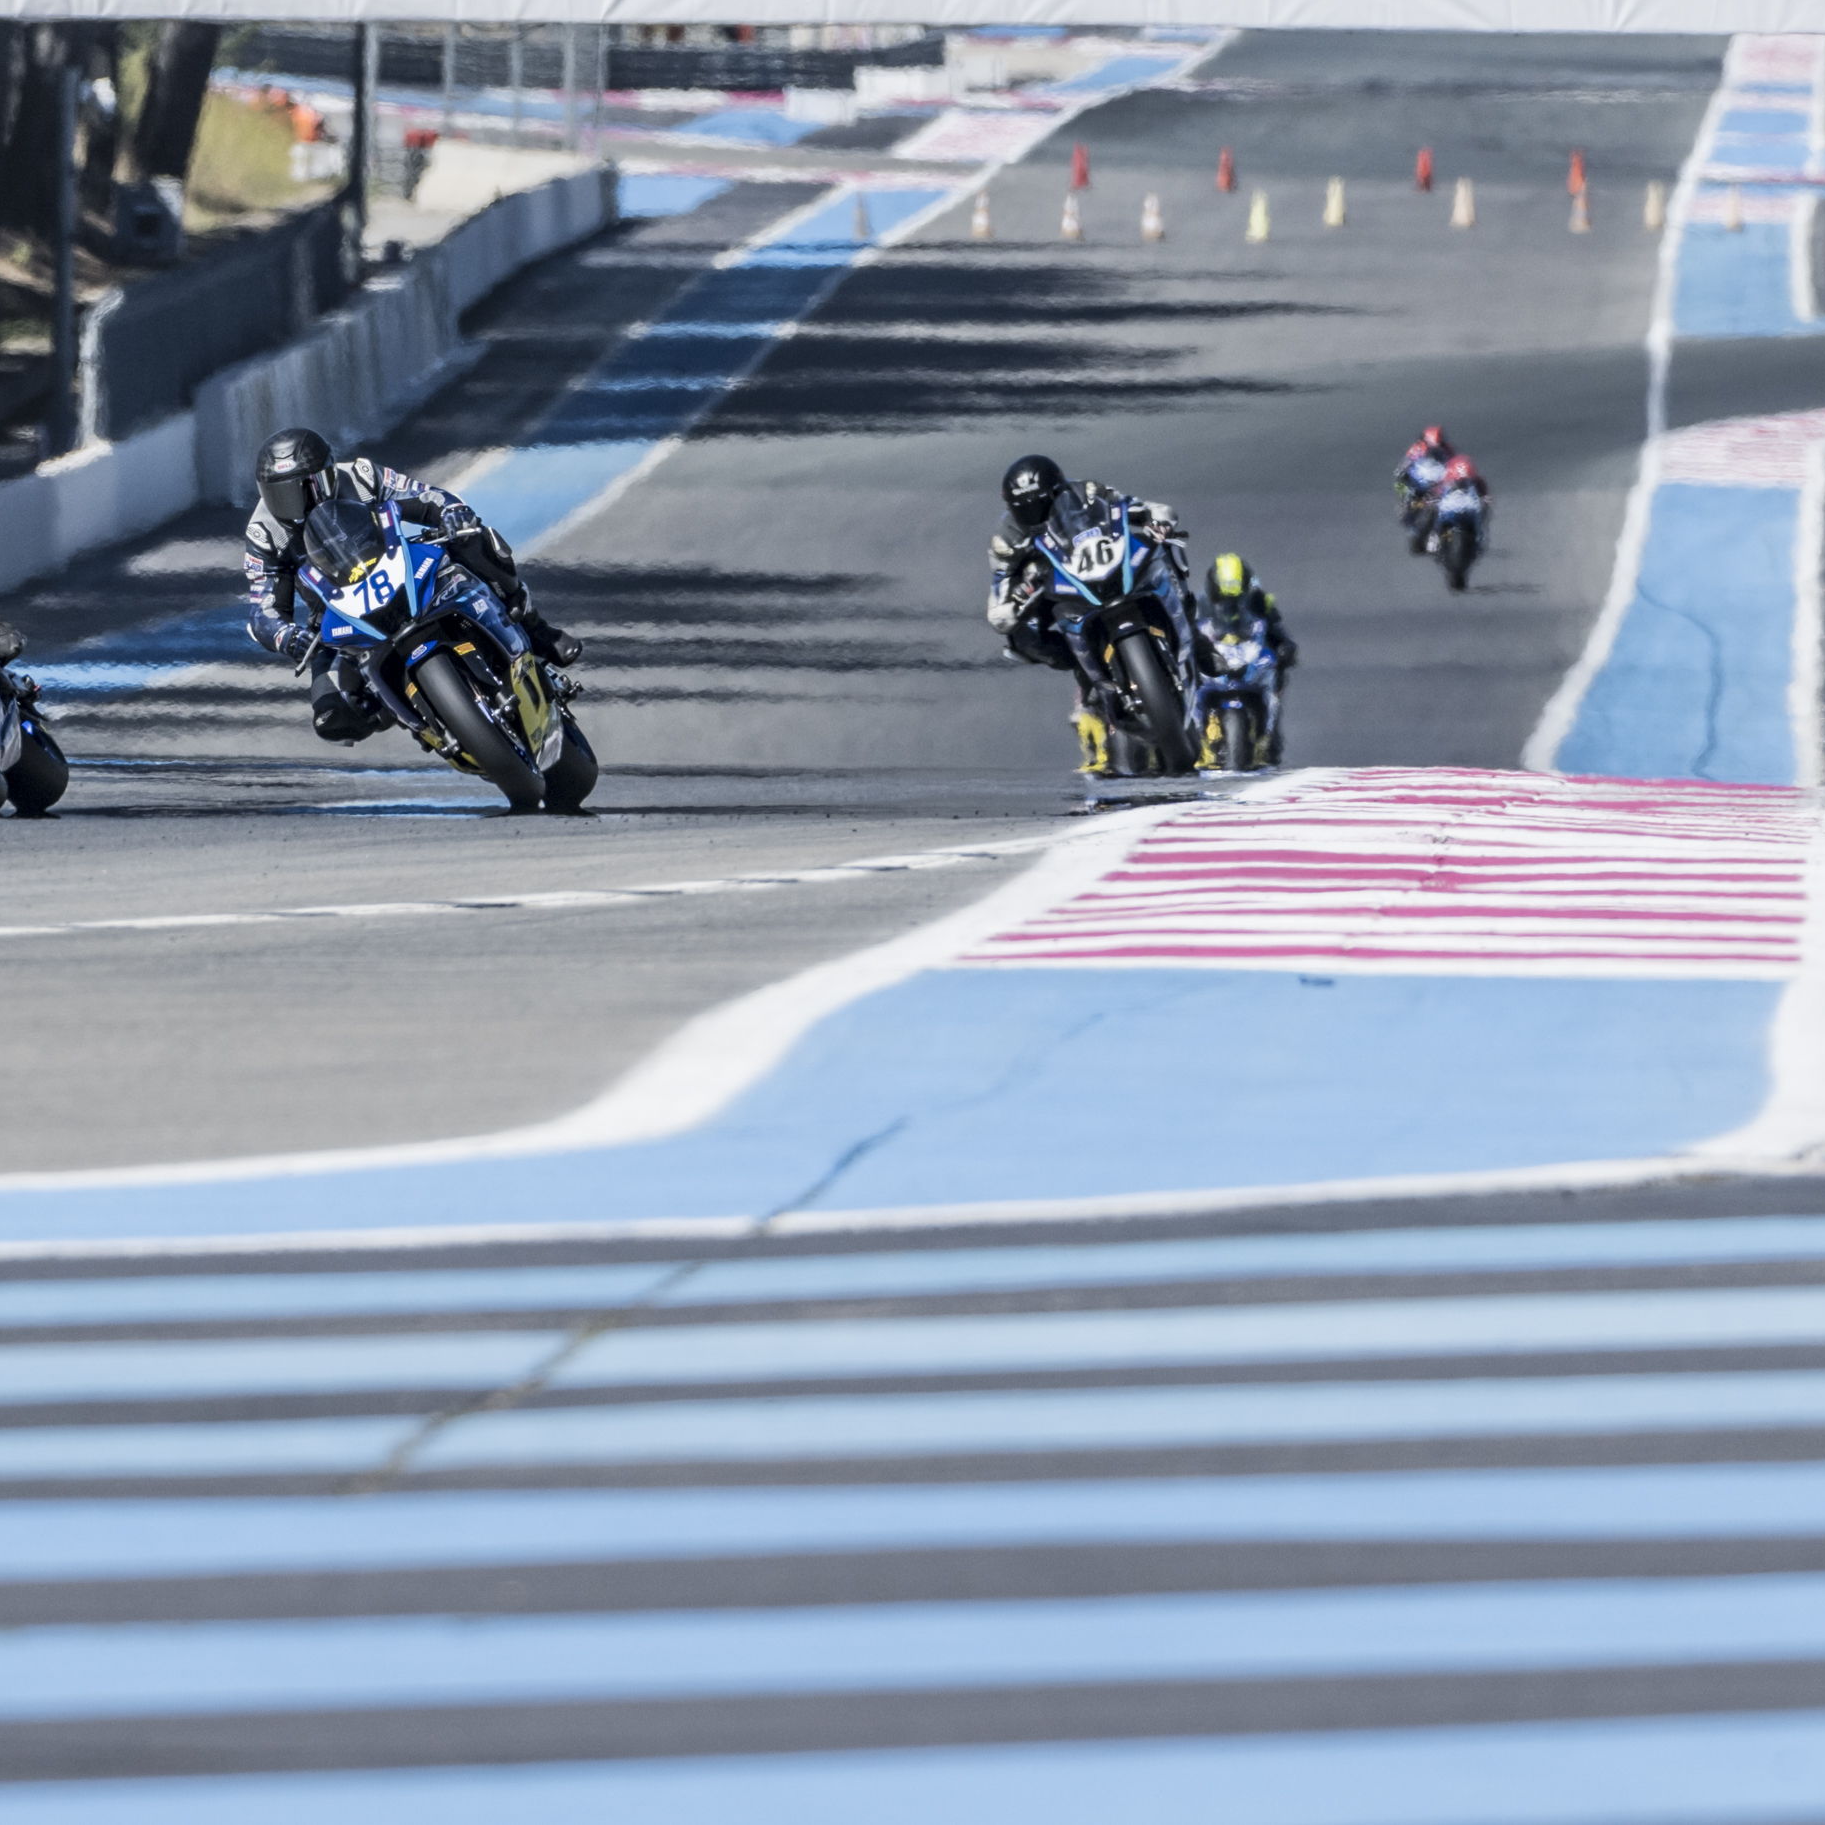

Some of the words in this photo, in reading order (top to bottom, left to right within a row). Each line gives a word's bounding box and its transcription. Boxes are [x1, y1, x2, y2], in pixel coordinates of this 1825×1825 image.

[413, 557, 435, 579] YAMAHA
[1077, 539, 1115, 575] 46
[352, 569, 396, 614] 78
[331, 625, 353, 636] YAMAHA
